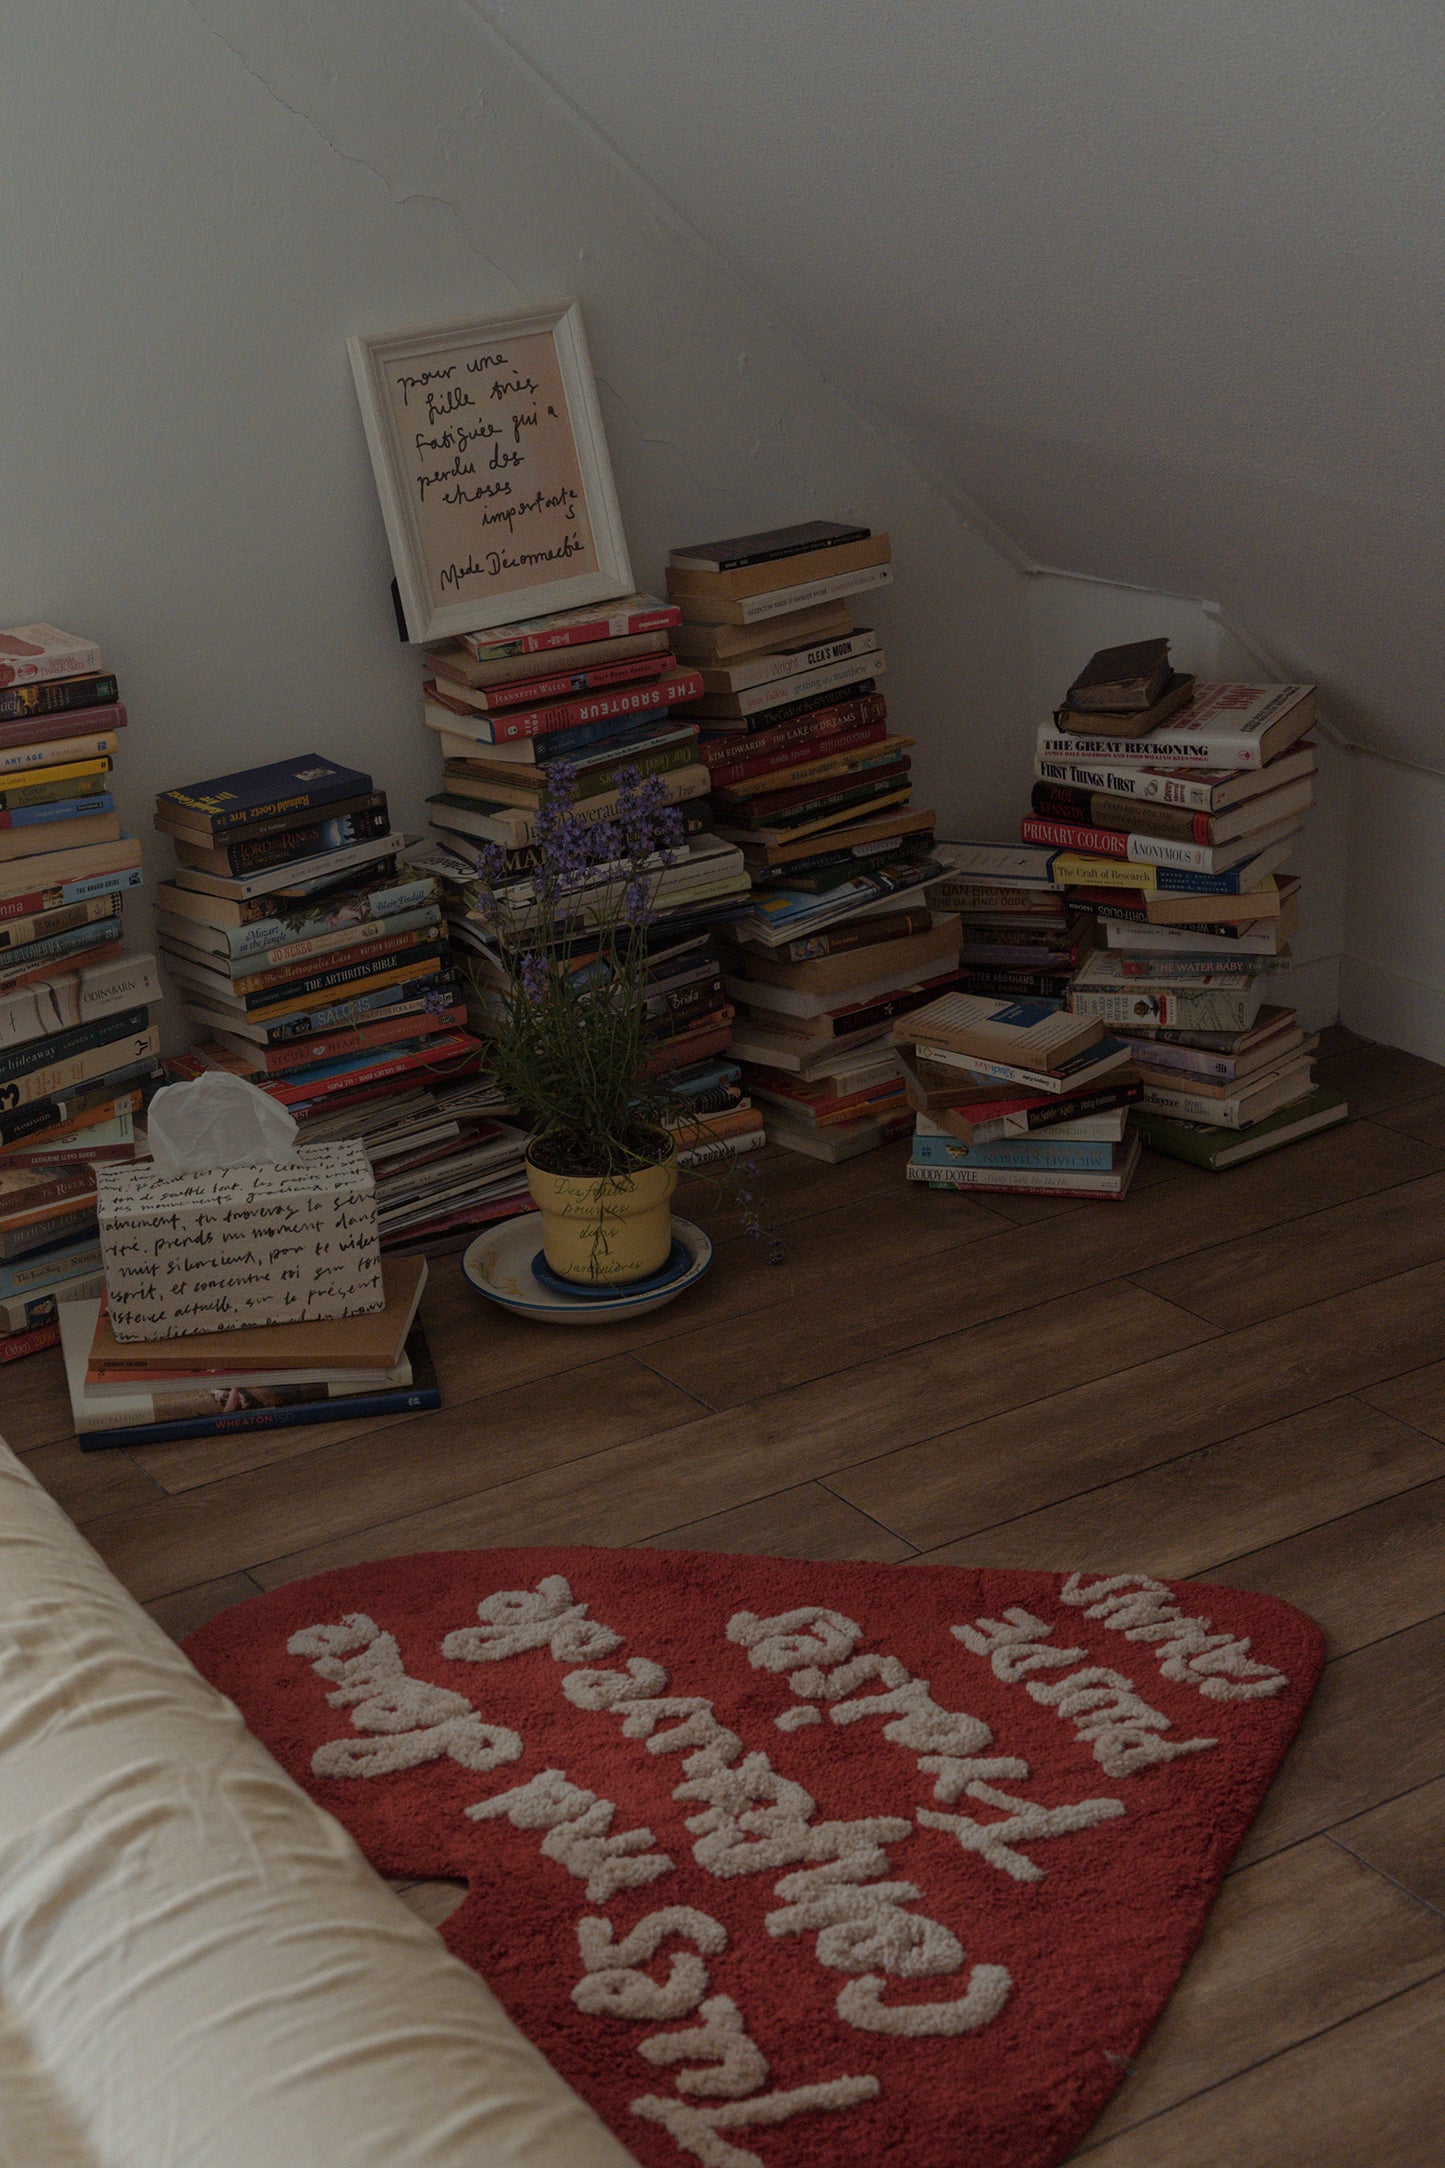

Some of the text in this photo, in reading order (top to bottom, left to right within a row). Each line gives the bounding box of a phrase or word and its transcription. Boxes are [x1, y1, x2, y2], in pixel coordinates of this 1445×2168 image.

[397, 354, 508, 405] pour une
[425, 371, 539, 424] fille très
[416, 402, 559, 462] fatiguée qui a
[417, 443, 525, 501] perdu des
[442, 482, 512, 505] choses
[807, 649, 831, 664] CLEA'S
[833, 641, 853, 657] MOON
[494, 682, 566, 705] JEANNETTE WALLS
[667, 681, 696, 698] THE
[580, 688, 661, 720] SABOTEUR
[530, 713, 539, 737] PAUL
[708, 748, 726, 763] KIM
[726, 738, 767, 758] EDWARDS
[786, 724, 810, 740] LAKE
[820, 712, 856, 732] DREAMS
[1043, 739, 1209, 757] THE GREAT RECKONING
[4, 753, 43, 766] ANY AGE
[1040, 762, 1136, 793] FIRST THINGS FIRST
[1039, 801, 1086, 822] KENNEDY
[240, 828, 320, 859] LORD RINGS
[1023, 822, 1191, 864] PRIMARY COLORS ANONYMOUS
[1057, 866, 1150, 883] The Craft of Research
[76, 879, 120, 895] THE ROUGH GUIDE
[245, 926, 278, 942] Mozart
[272, 951, 283, 963] JO
[1154, 960, 1244, 973] THE WATER BABY
[304, 956, 399, 992] THE ARTHRITIS BIBLE
[8, 1046, 57, 1073] hideaway
[908, 1167, 978, 1184] RODDY DOYLE
[215, 1414, 272, 1430] WHEATON
